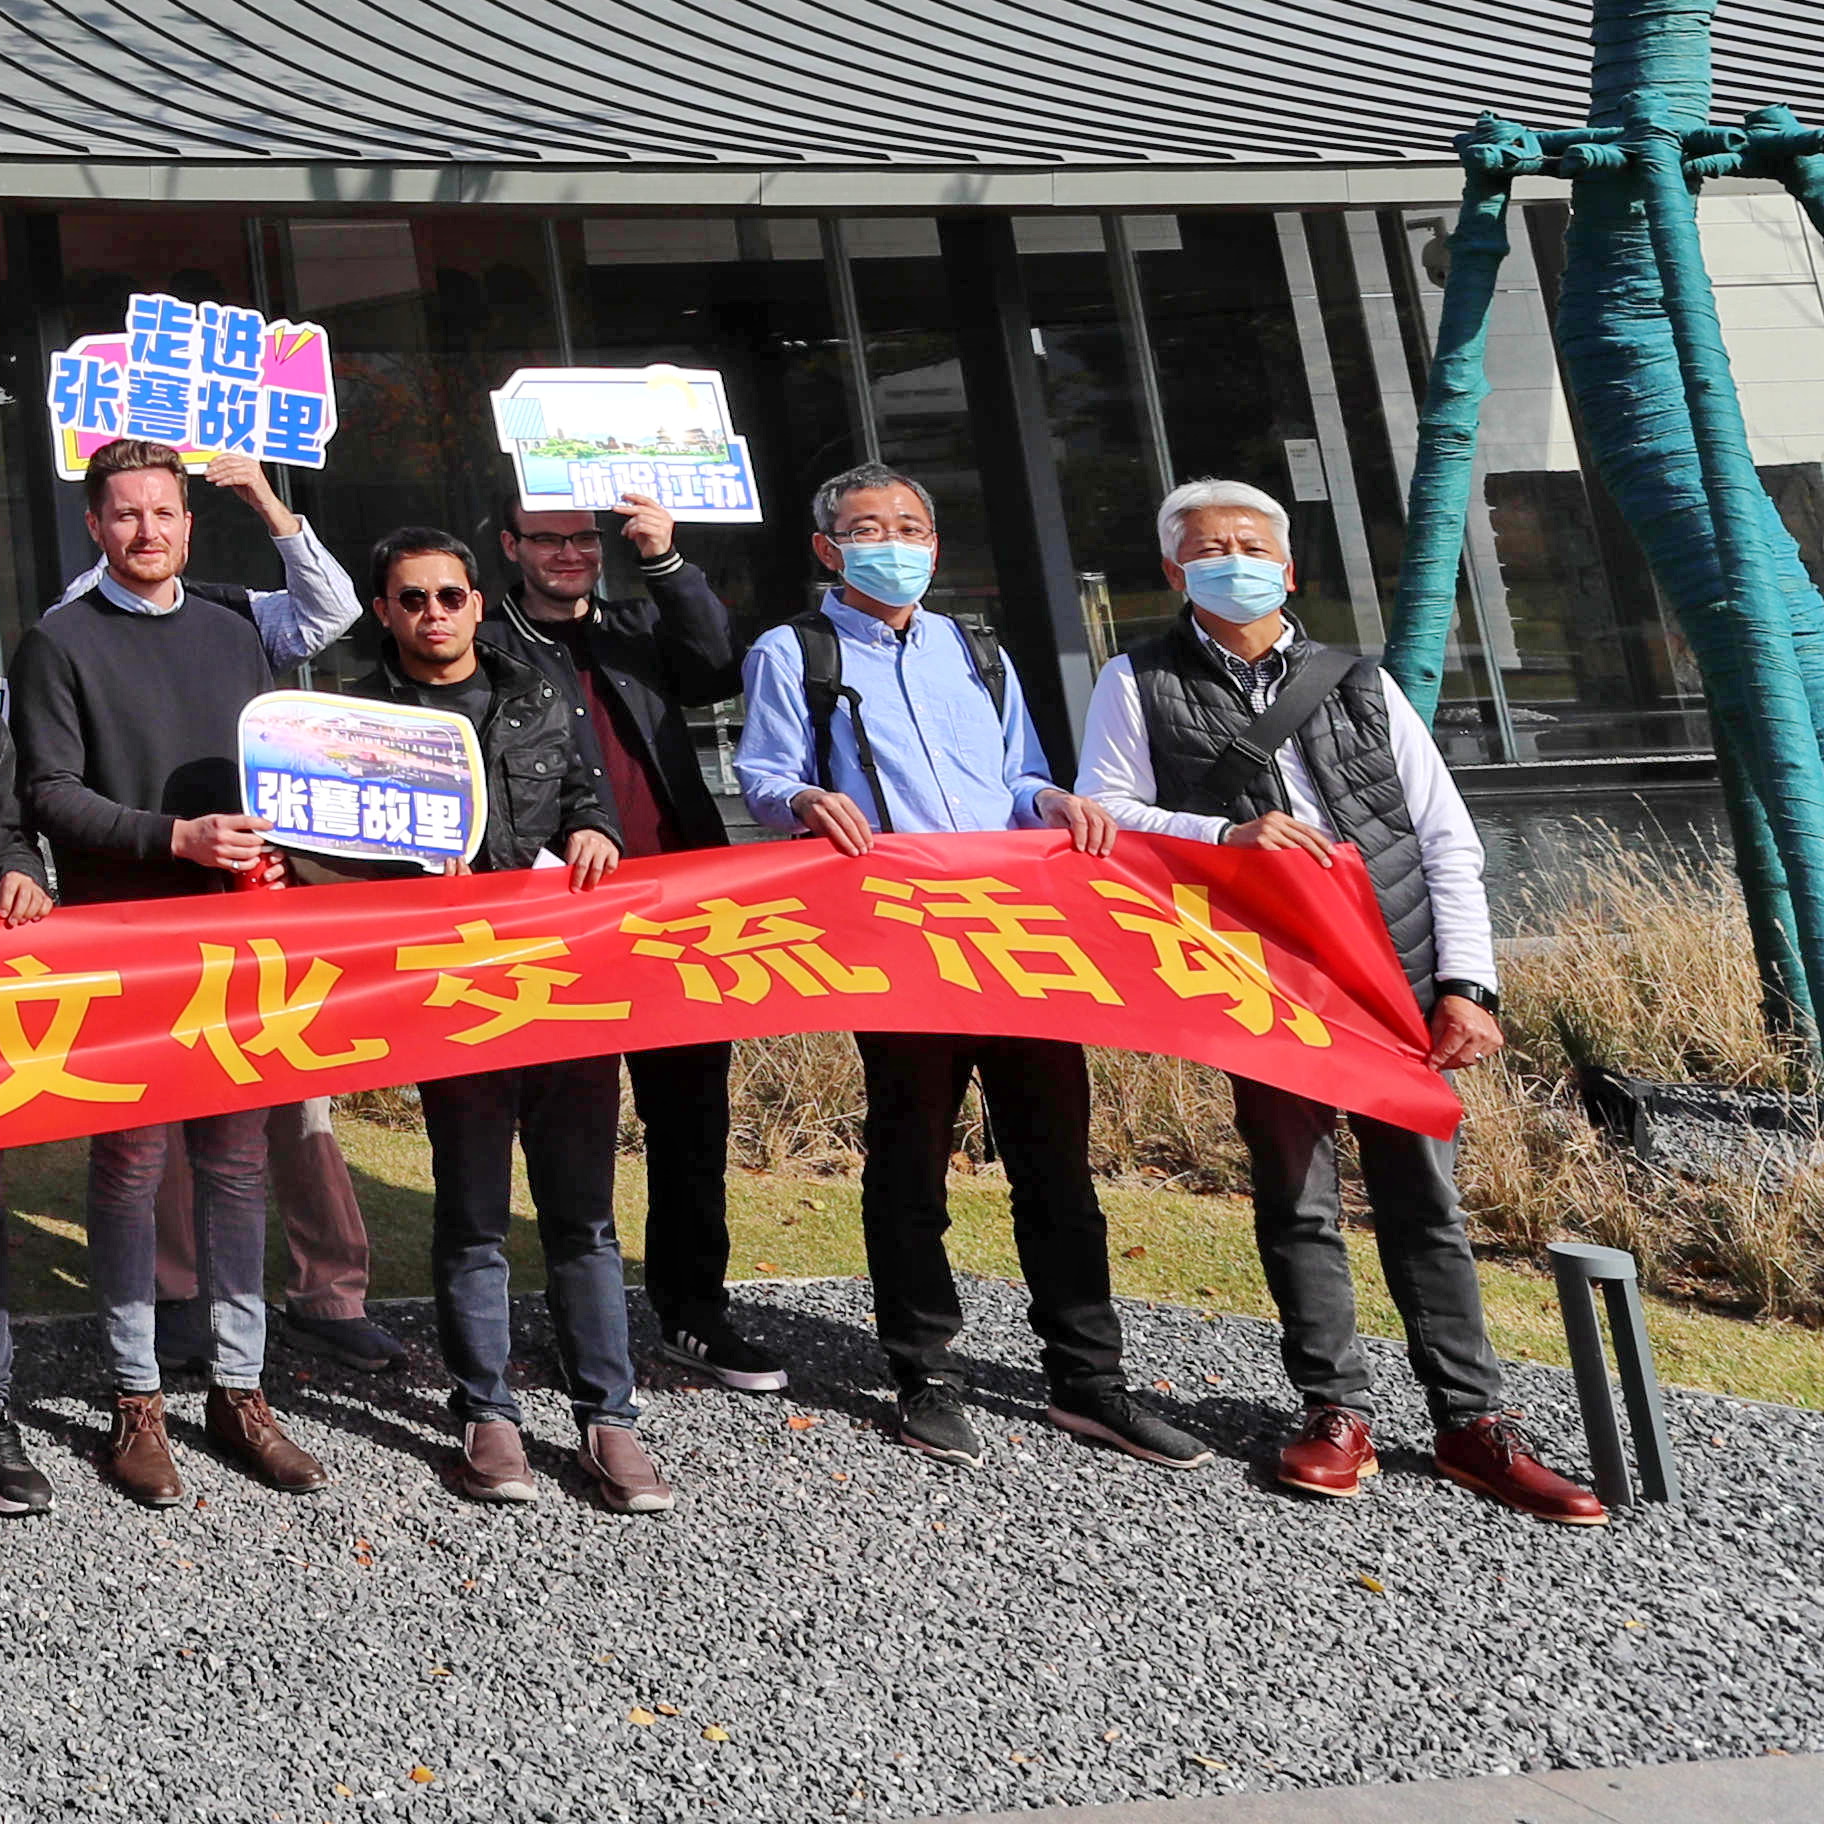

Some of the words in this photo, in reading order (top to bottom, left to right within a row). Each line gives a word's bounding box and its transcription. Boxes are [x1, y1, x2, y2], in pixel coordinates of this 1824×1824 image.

[131, 298, 263, 382] 走进
[53, 357, 325, 464] 张謇故里
[568, 461, 748, 509] 体验江苏
[257, 771, 465, 852] 张謇故里
